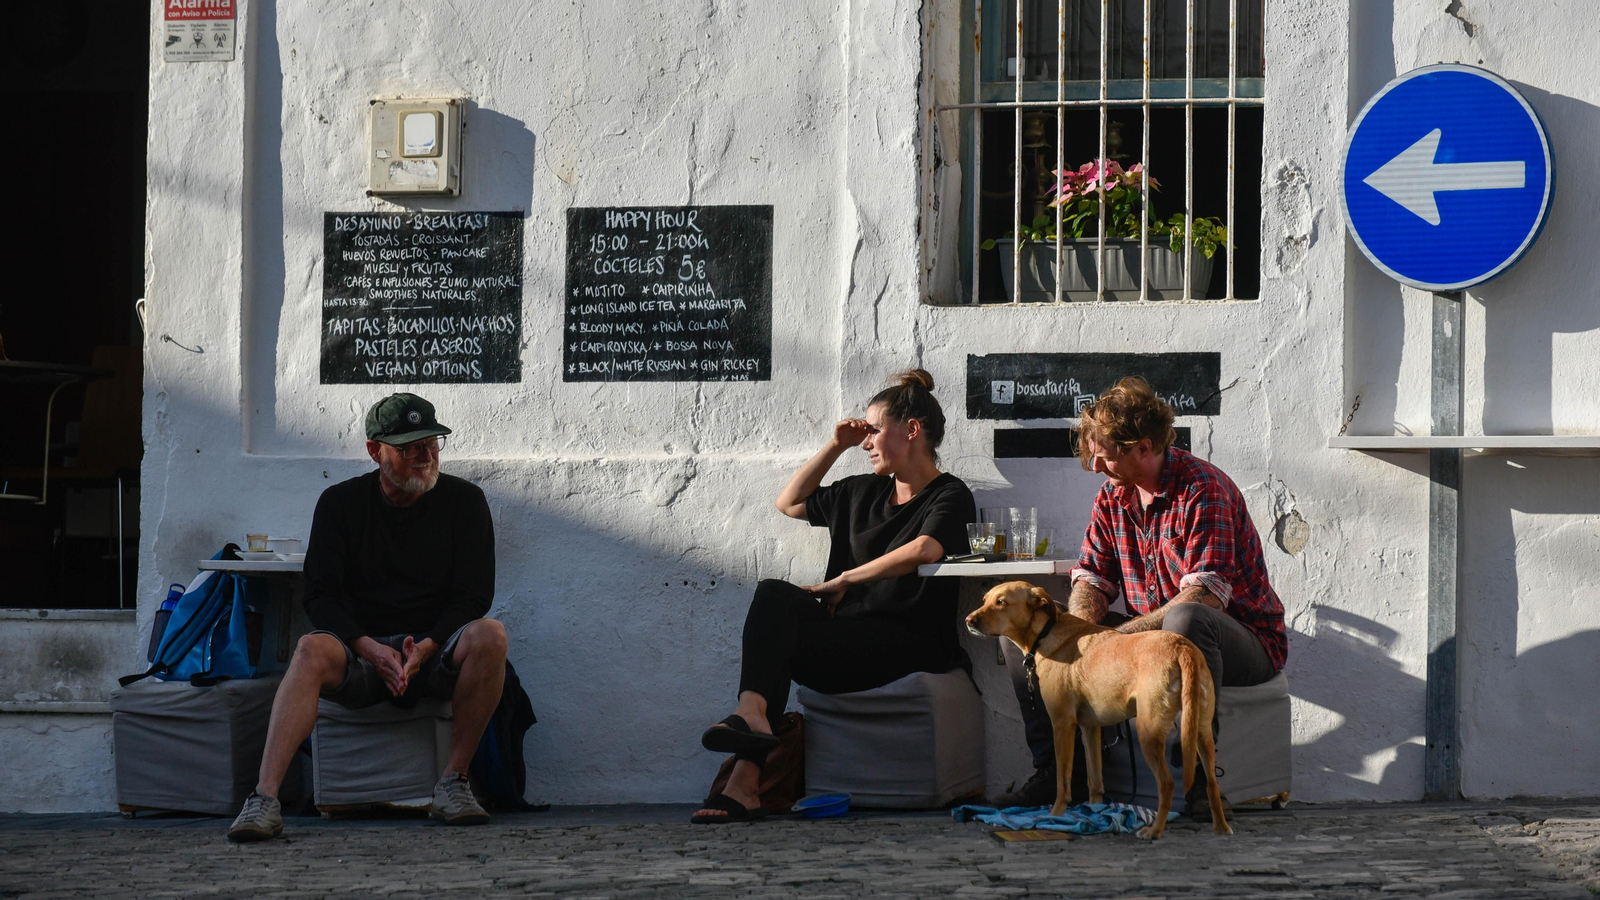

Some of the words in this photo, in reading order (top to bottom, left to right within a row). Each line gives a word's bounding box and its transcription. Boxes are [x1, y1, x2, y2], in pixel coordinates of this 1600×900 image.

[168, 0, 231, 9] Alarma
[335, 216, 401, 232] DESAYUNO
[413, 213, 490, 231] BREAKFAST
[605, 210, 651, 231] HAPPY
[655, 209, 702, 232] HOUR
[352, 234, 400, 247] TOSTADAS
[411, 233, 472, 246] CROISSANT
[589, 234, 629, 253] 15:00
[655, 232, 710, 251] 21:00h
[342, 249, 377, 262] HUEVOS
[380, 247, 430, 261] REVUELTOS
[441, 246, 490, 259] PANCAKE
[363, 263, 399, 275] MUESLI
[411, 261, 453, 276] FRUTAS
[594, 254, 665, 275] CÓCTELES
[382, 276, 433, 288] INFUSIONES
[439, 276, 469, 289] ZUMO
[472, 275, 520, 289] NATURAL
[369, 288, 418, 300] SMOOTHIES
[422, 288, 477, 300] NATURALES
[585, 283, 626, 298] MOJITO
[323, 297, 348, 308] HASTA
[580, 302, 604, 315] LONG
[605, 301, 637, 314] ISLAND
[639, 300, 656, 312] ICE
[657, 300, 676, 312] TEA
[688, 298, 747, 311] MARGARITA
[326, 317, 380, 336] TAPITAS
[387, 315, 456, 335] BOCADILLOS
[460, 312, 515, 334] NACHOS
[579, 322, 614, 335] BLOODY
[688, 318, 729, 331] COLADA
[355, 338, 418, 357] PASTELES
[421, 336, 482, 356] CASEROS
[666, 340, 698, 352] BOSSA
[703, 339, 735, 351] NOVA
[365, 360, 417, 378] VEGAN
[422, 359, 482, 379] OPTIONS
[646, 359, 687, 373] RUSSIAN
[700, 359, 719, 372] GIN
[722, 358, 760, 373] RICKEY
[1016, 377, 1083, 396] bossatarifa
